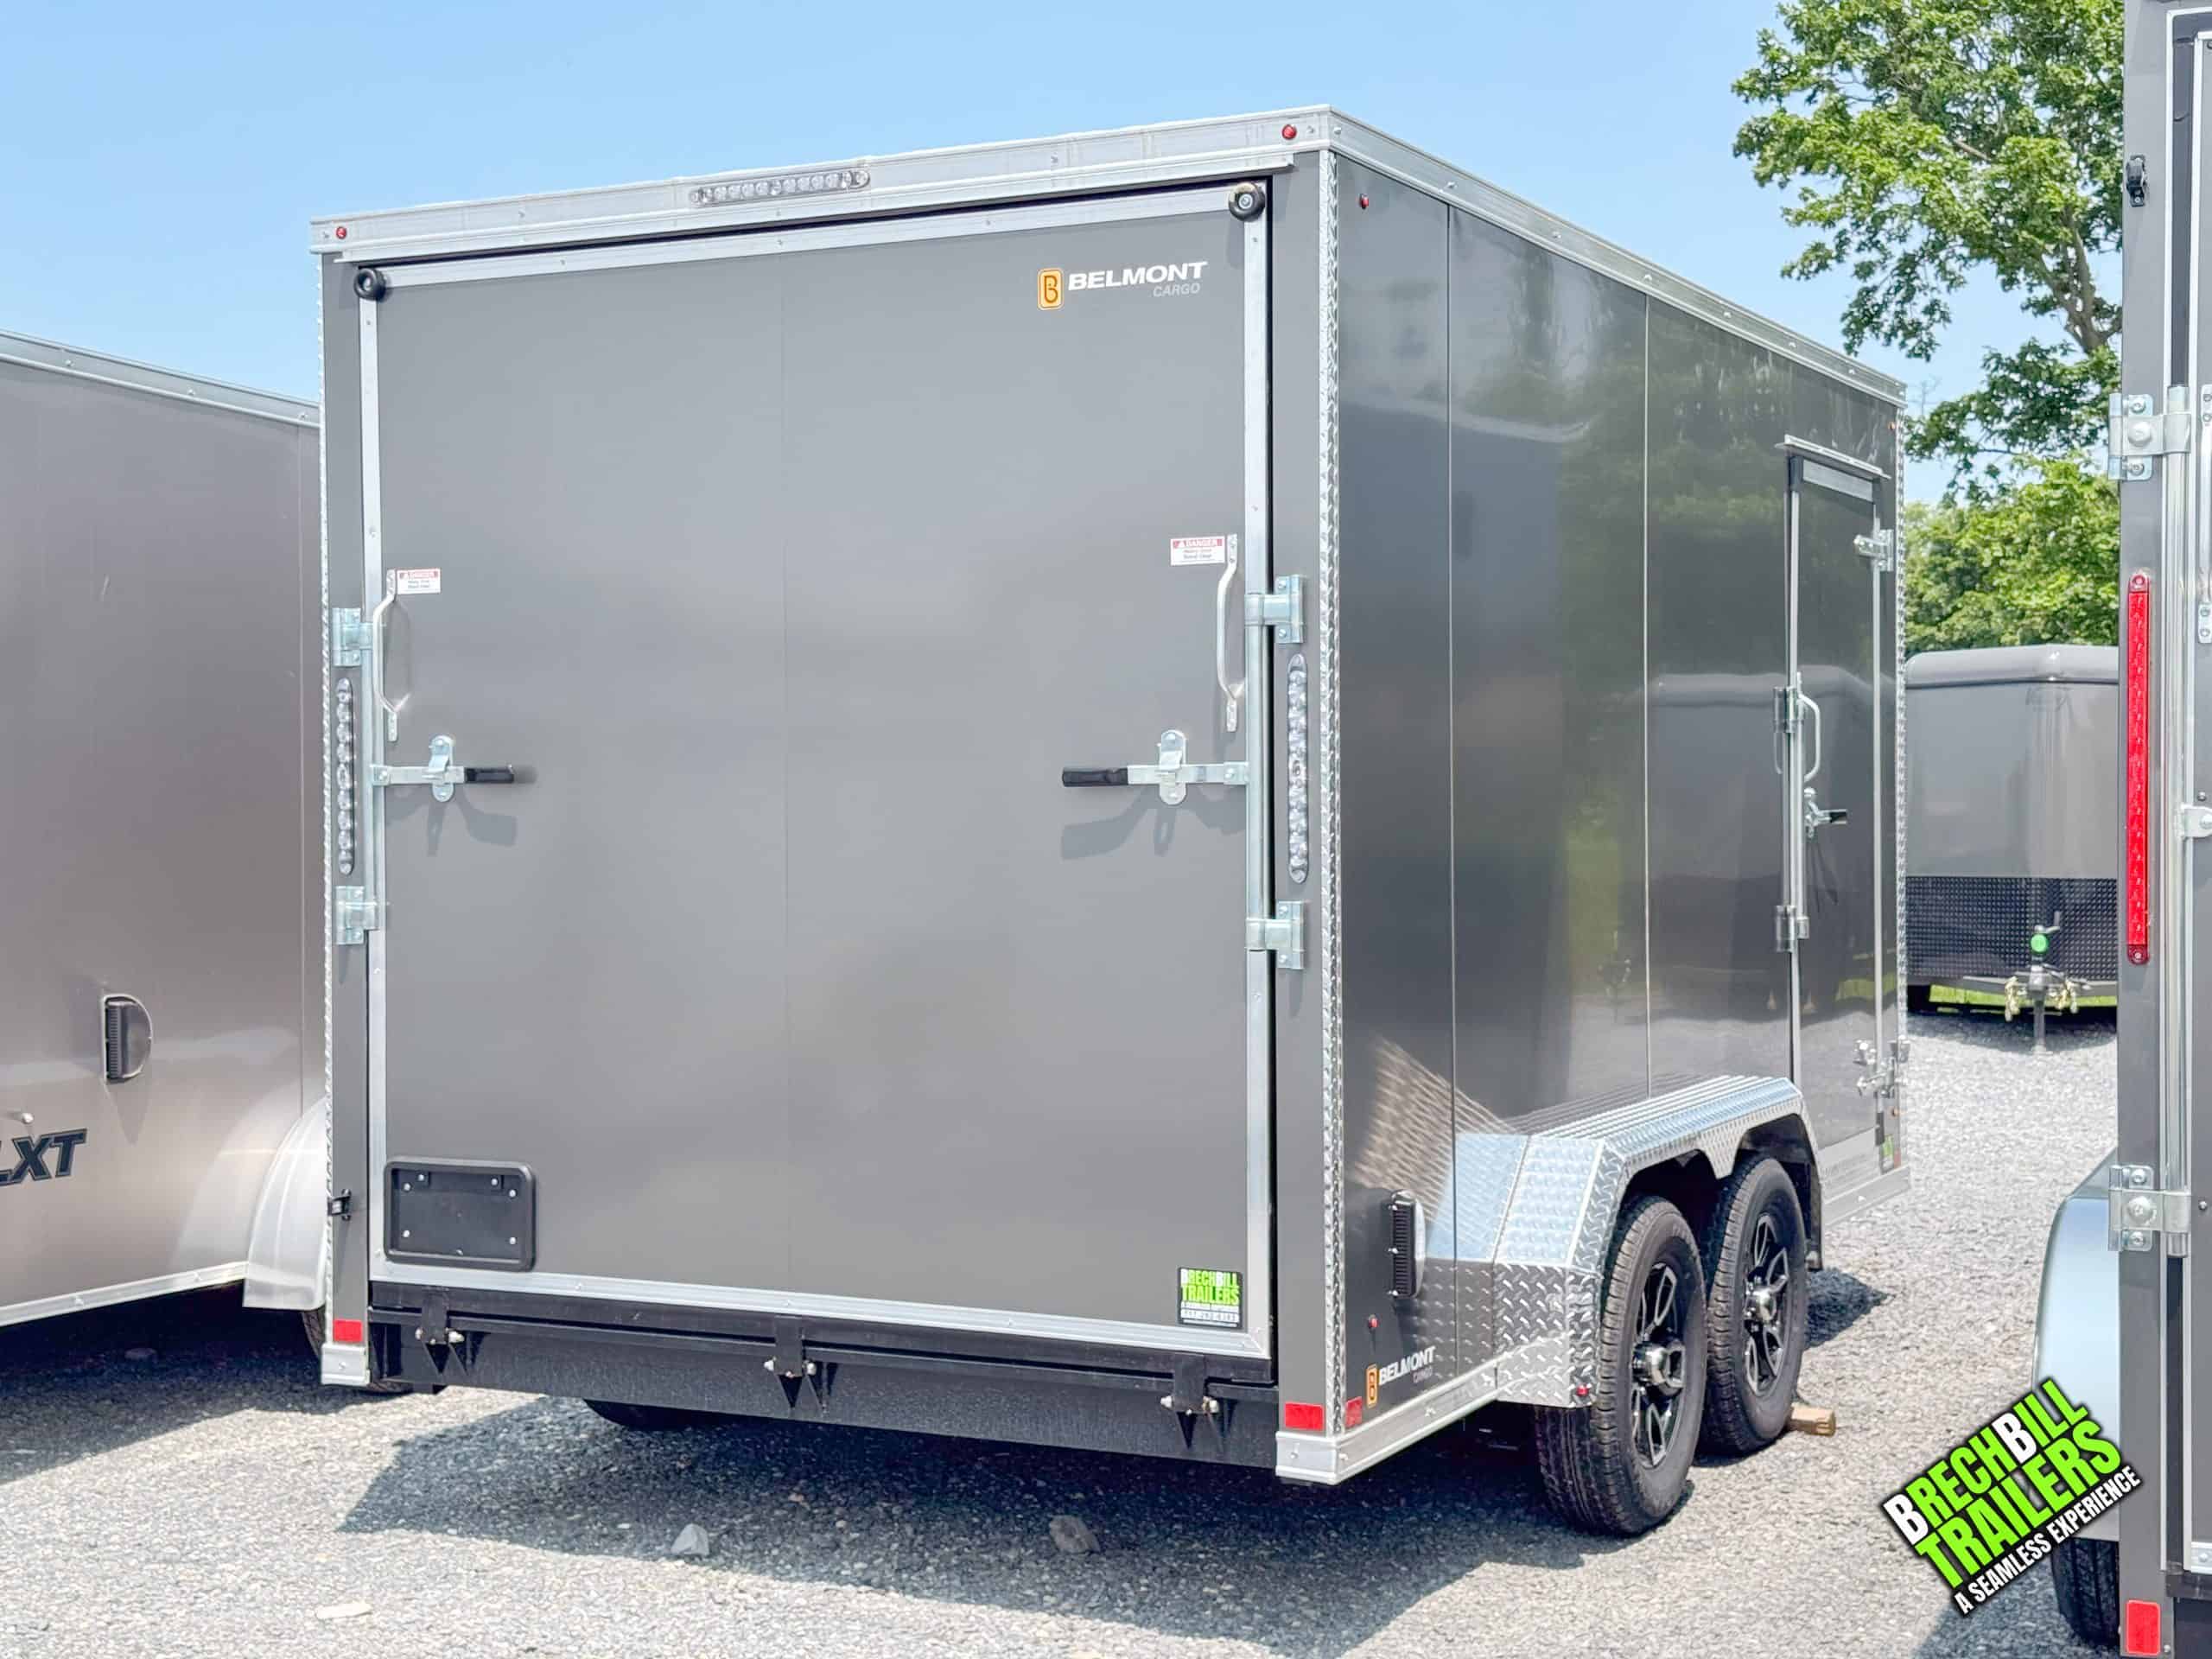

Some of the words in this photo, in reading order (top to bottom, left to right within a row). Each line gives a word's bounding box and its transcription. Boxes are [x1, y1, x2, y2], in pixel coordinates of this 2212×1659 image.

[1068, 261, 1208, 290] BELMONT
[1153, 283, 1201, 297] CARGO
[1182, 1285, 1239, 1306] TRAILERS
[1379, 1346, 1436, 1385] BELMONT
